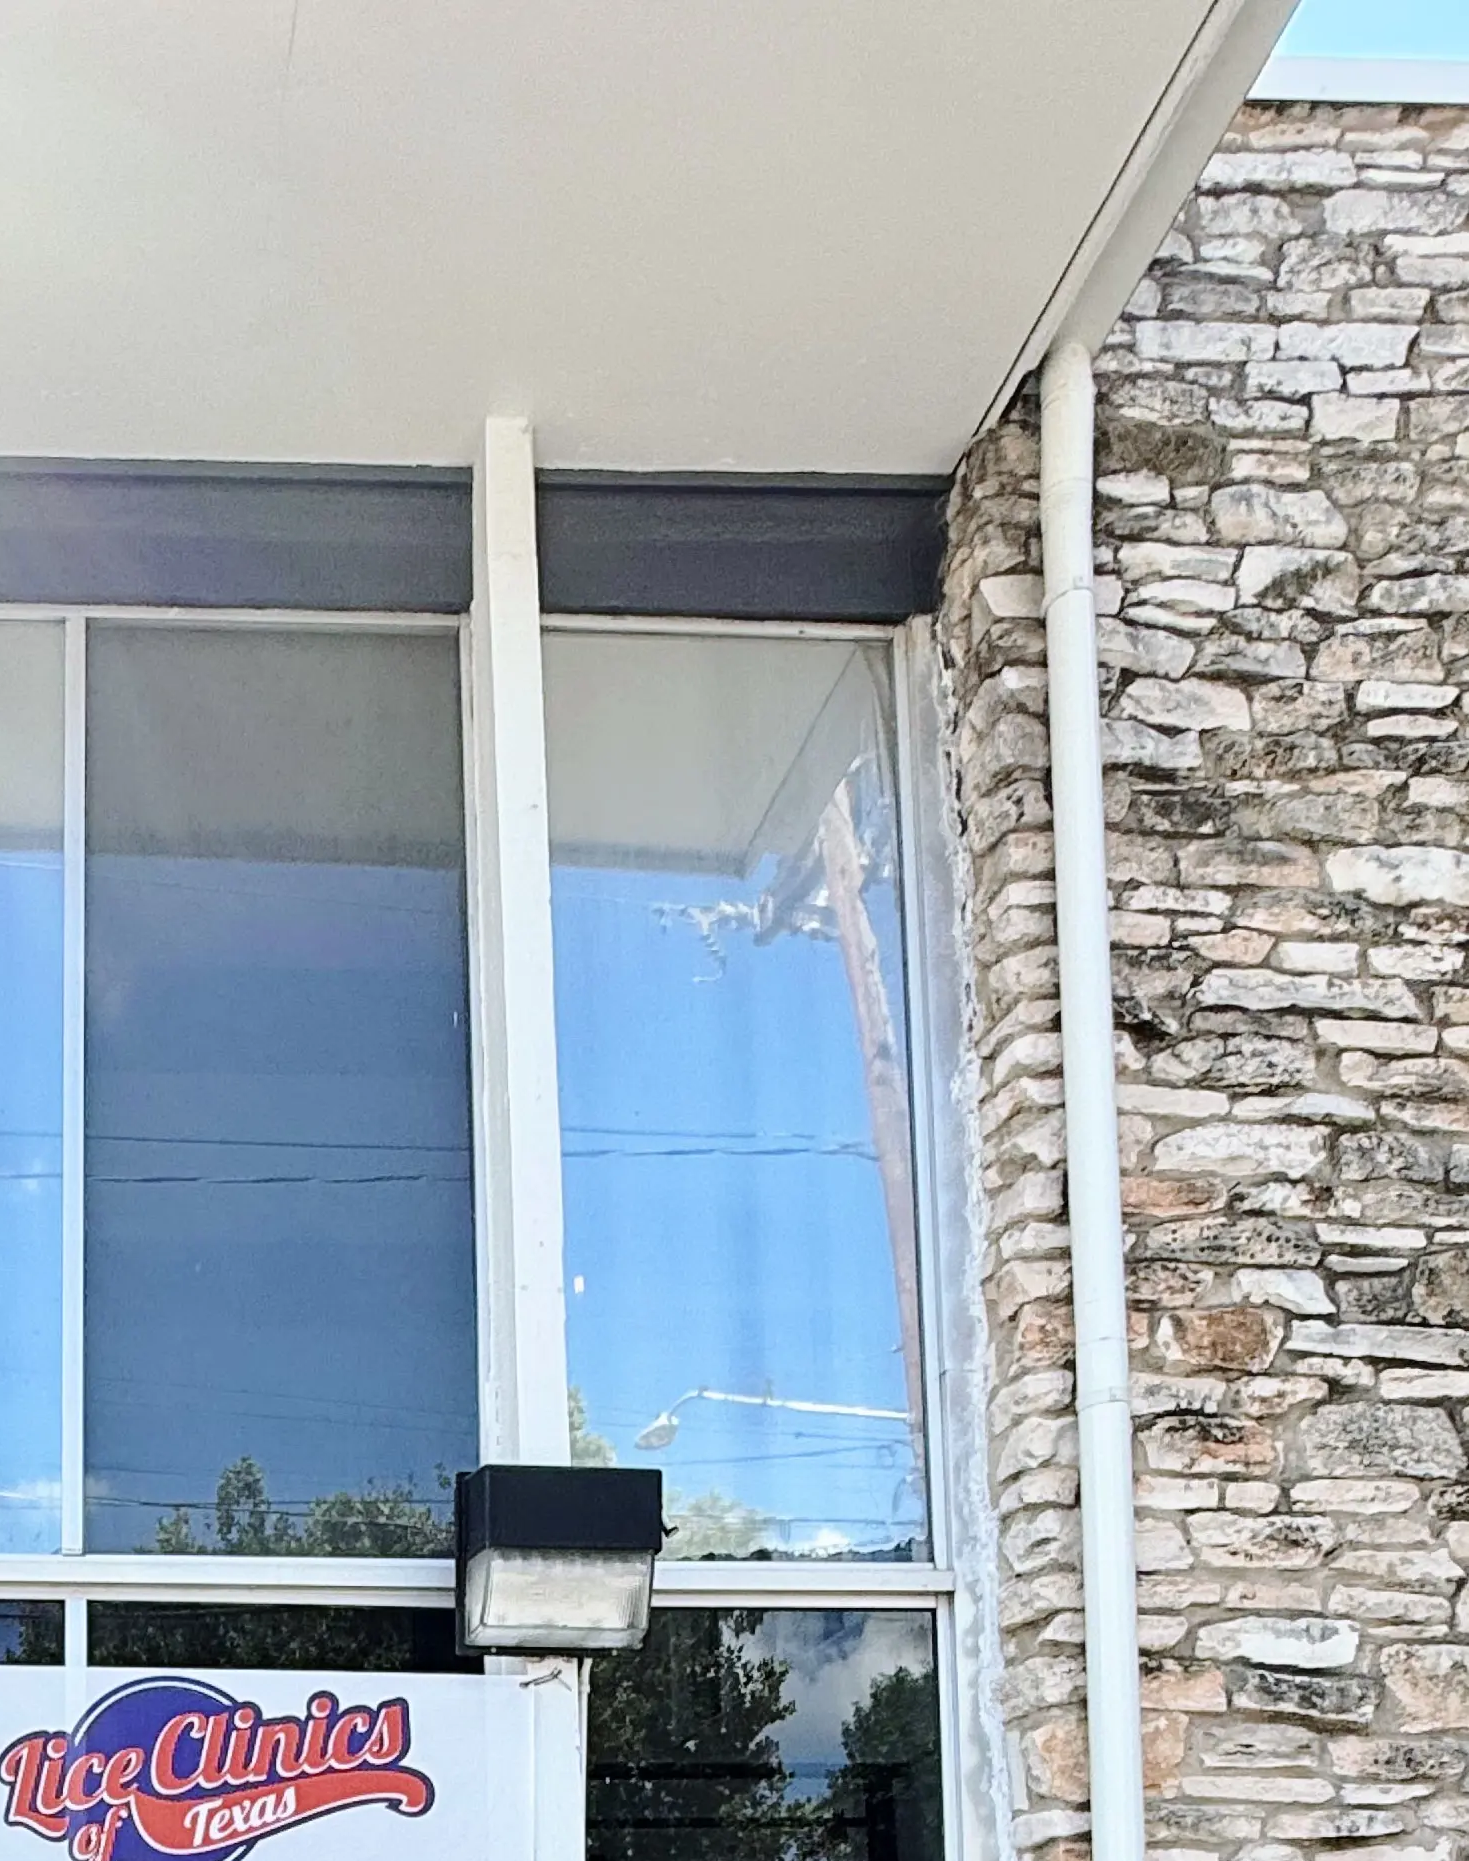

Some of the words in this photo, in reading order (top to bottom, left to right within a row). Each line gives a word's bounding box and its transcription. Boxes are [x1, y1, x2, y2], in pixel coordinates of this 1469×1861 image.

[0, 1733, 145, 1842] Lice
[150, 1695, 405, 1796] Clinics
[183, 1785, 297, 1848] Texas
